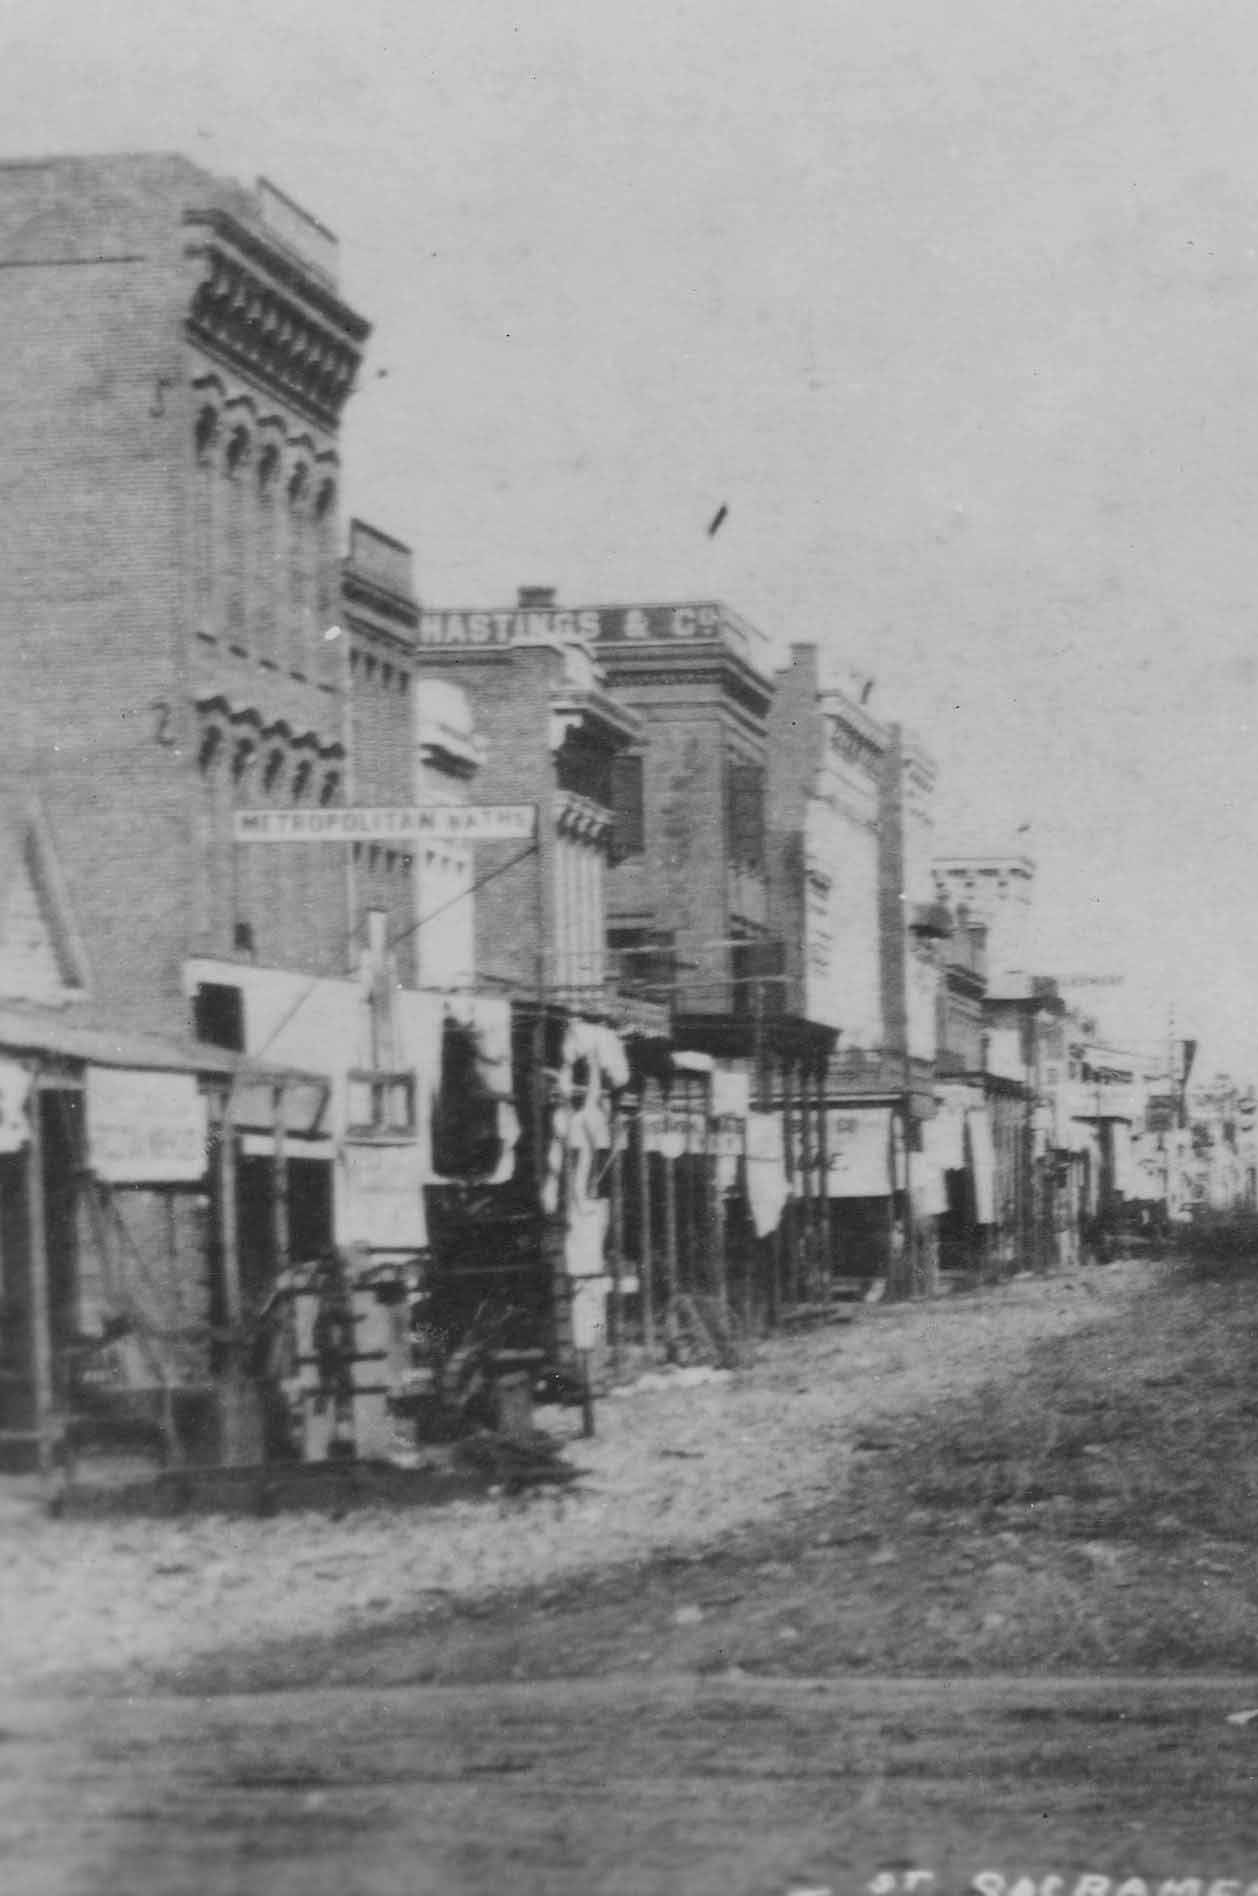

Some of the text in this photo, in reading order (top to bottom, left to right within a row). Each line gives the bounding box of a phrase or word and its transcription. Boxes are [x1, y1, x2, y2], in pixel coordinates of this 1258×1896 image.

[418, 610, 601, 643] HASTINGS
[624, 609, 648, 638] &
[241, 812, 436, 833] METROPOLITAN
